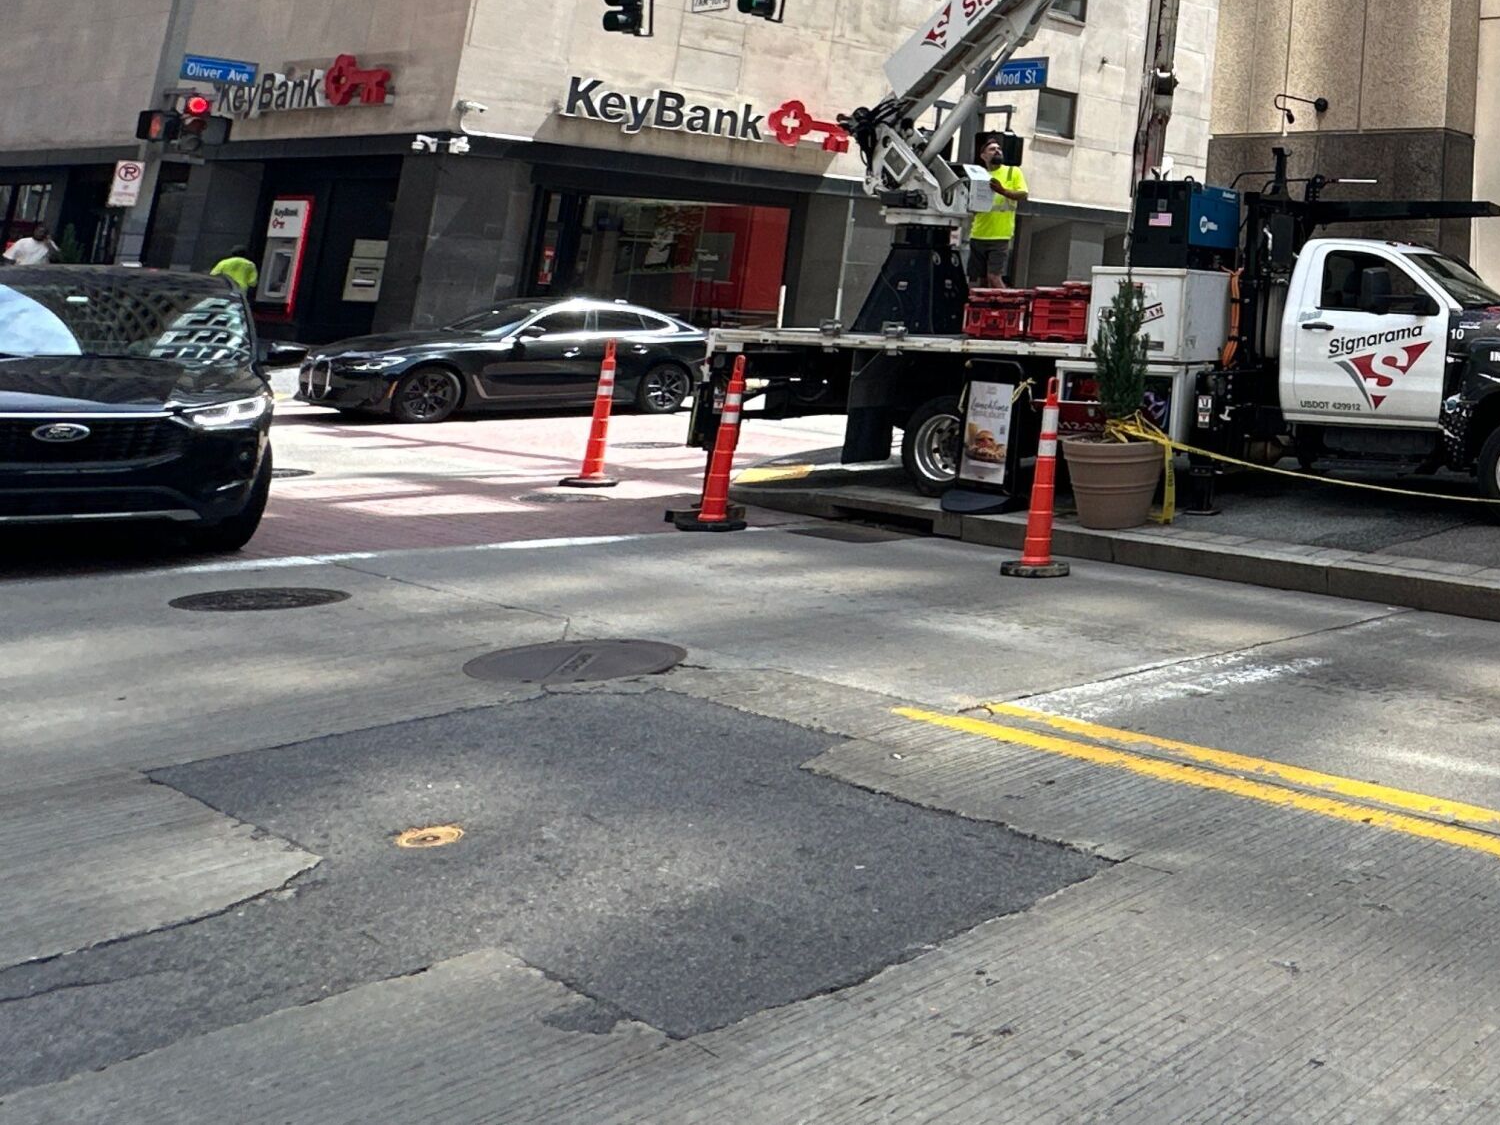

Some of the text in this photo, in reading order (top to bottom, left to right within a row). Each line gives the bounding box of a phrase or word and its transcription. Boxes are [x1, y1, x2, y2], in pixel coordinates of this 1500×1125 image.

[187, 62, 249, 82] Oliver Ave
[995, 69, 1037, 85] Wood St
[565, 76, 764, 140] KeyBank
[1328, 325, 1423, 355] Signarama
[1450, 328, 1464, 340] 10
[1300, 400, 1329, 410] USDOT
